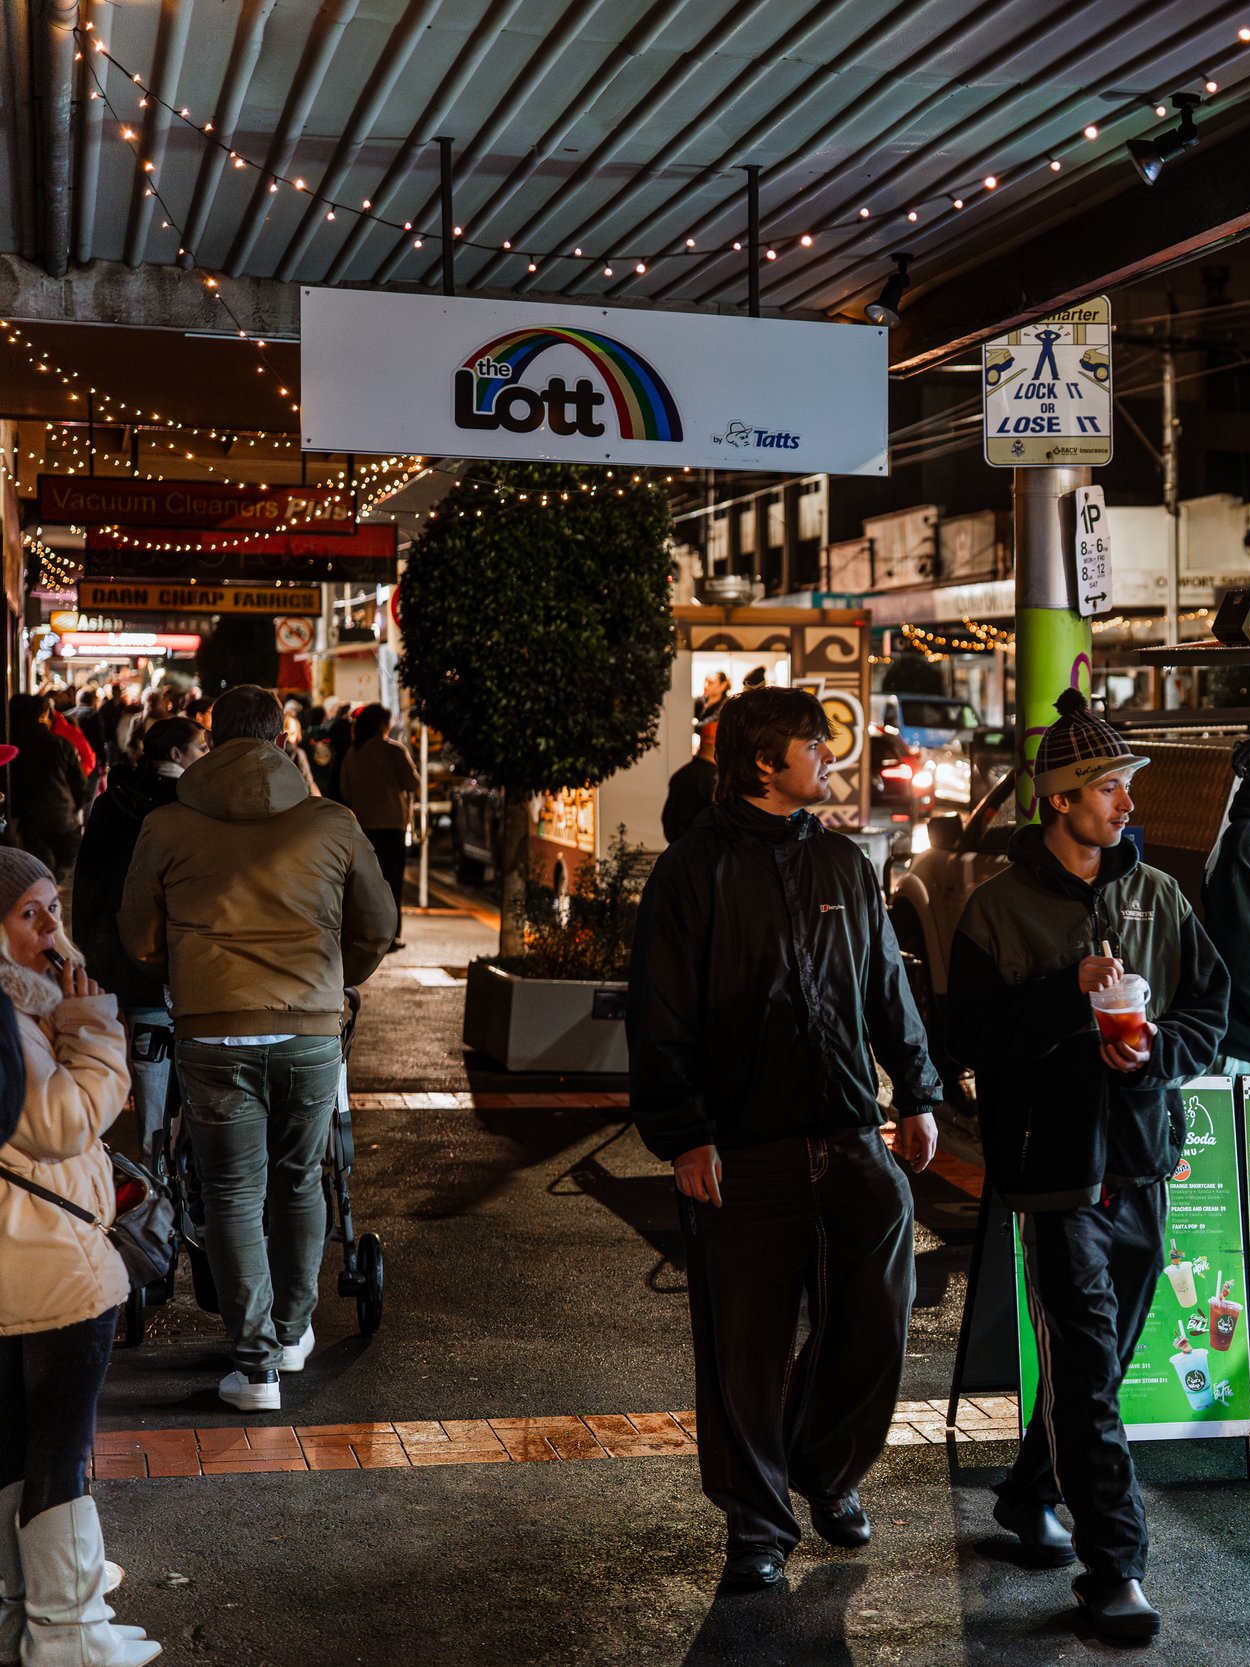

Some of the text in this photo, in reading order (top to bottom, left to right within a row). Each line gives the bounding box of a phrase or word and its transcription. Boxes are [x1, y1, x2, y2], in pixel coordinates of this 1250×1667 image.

[1048, 309, 1099, 320] arter
[477, 358, 511, 377] the
[1014, 383, 1083, 400] LOCK IT
[455, 370, 605, 437] Lott
[1040, 403, 1055, 414] OR
[996, 416, 1101, 433] LOSE IT
[713, 430, 800, 449] by Tatts
[52, 488, 348, 522] Vacuum Cleaners Plus
[1081, 504, 1100, 534] 1P
[1097, 563, 1105, 574] 12
[92, 588, 148, 605] DARN
[159, 590, 224, 606] CHEAP
[1186, 1132, 1216, 1145] Soda
[1181, 1148, 1197, 1157] NU
